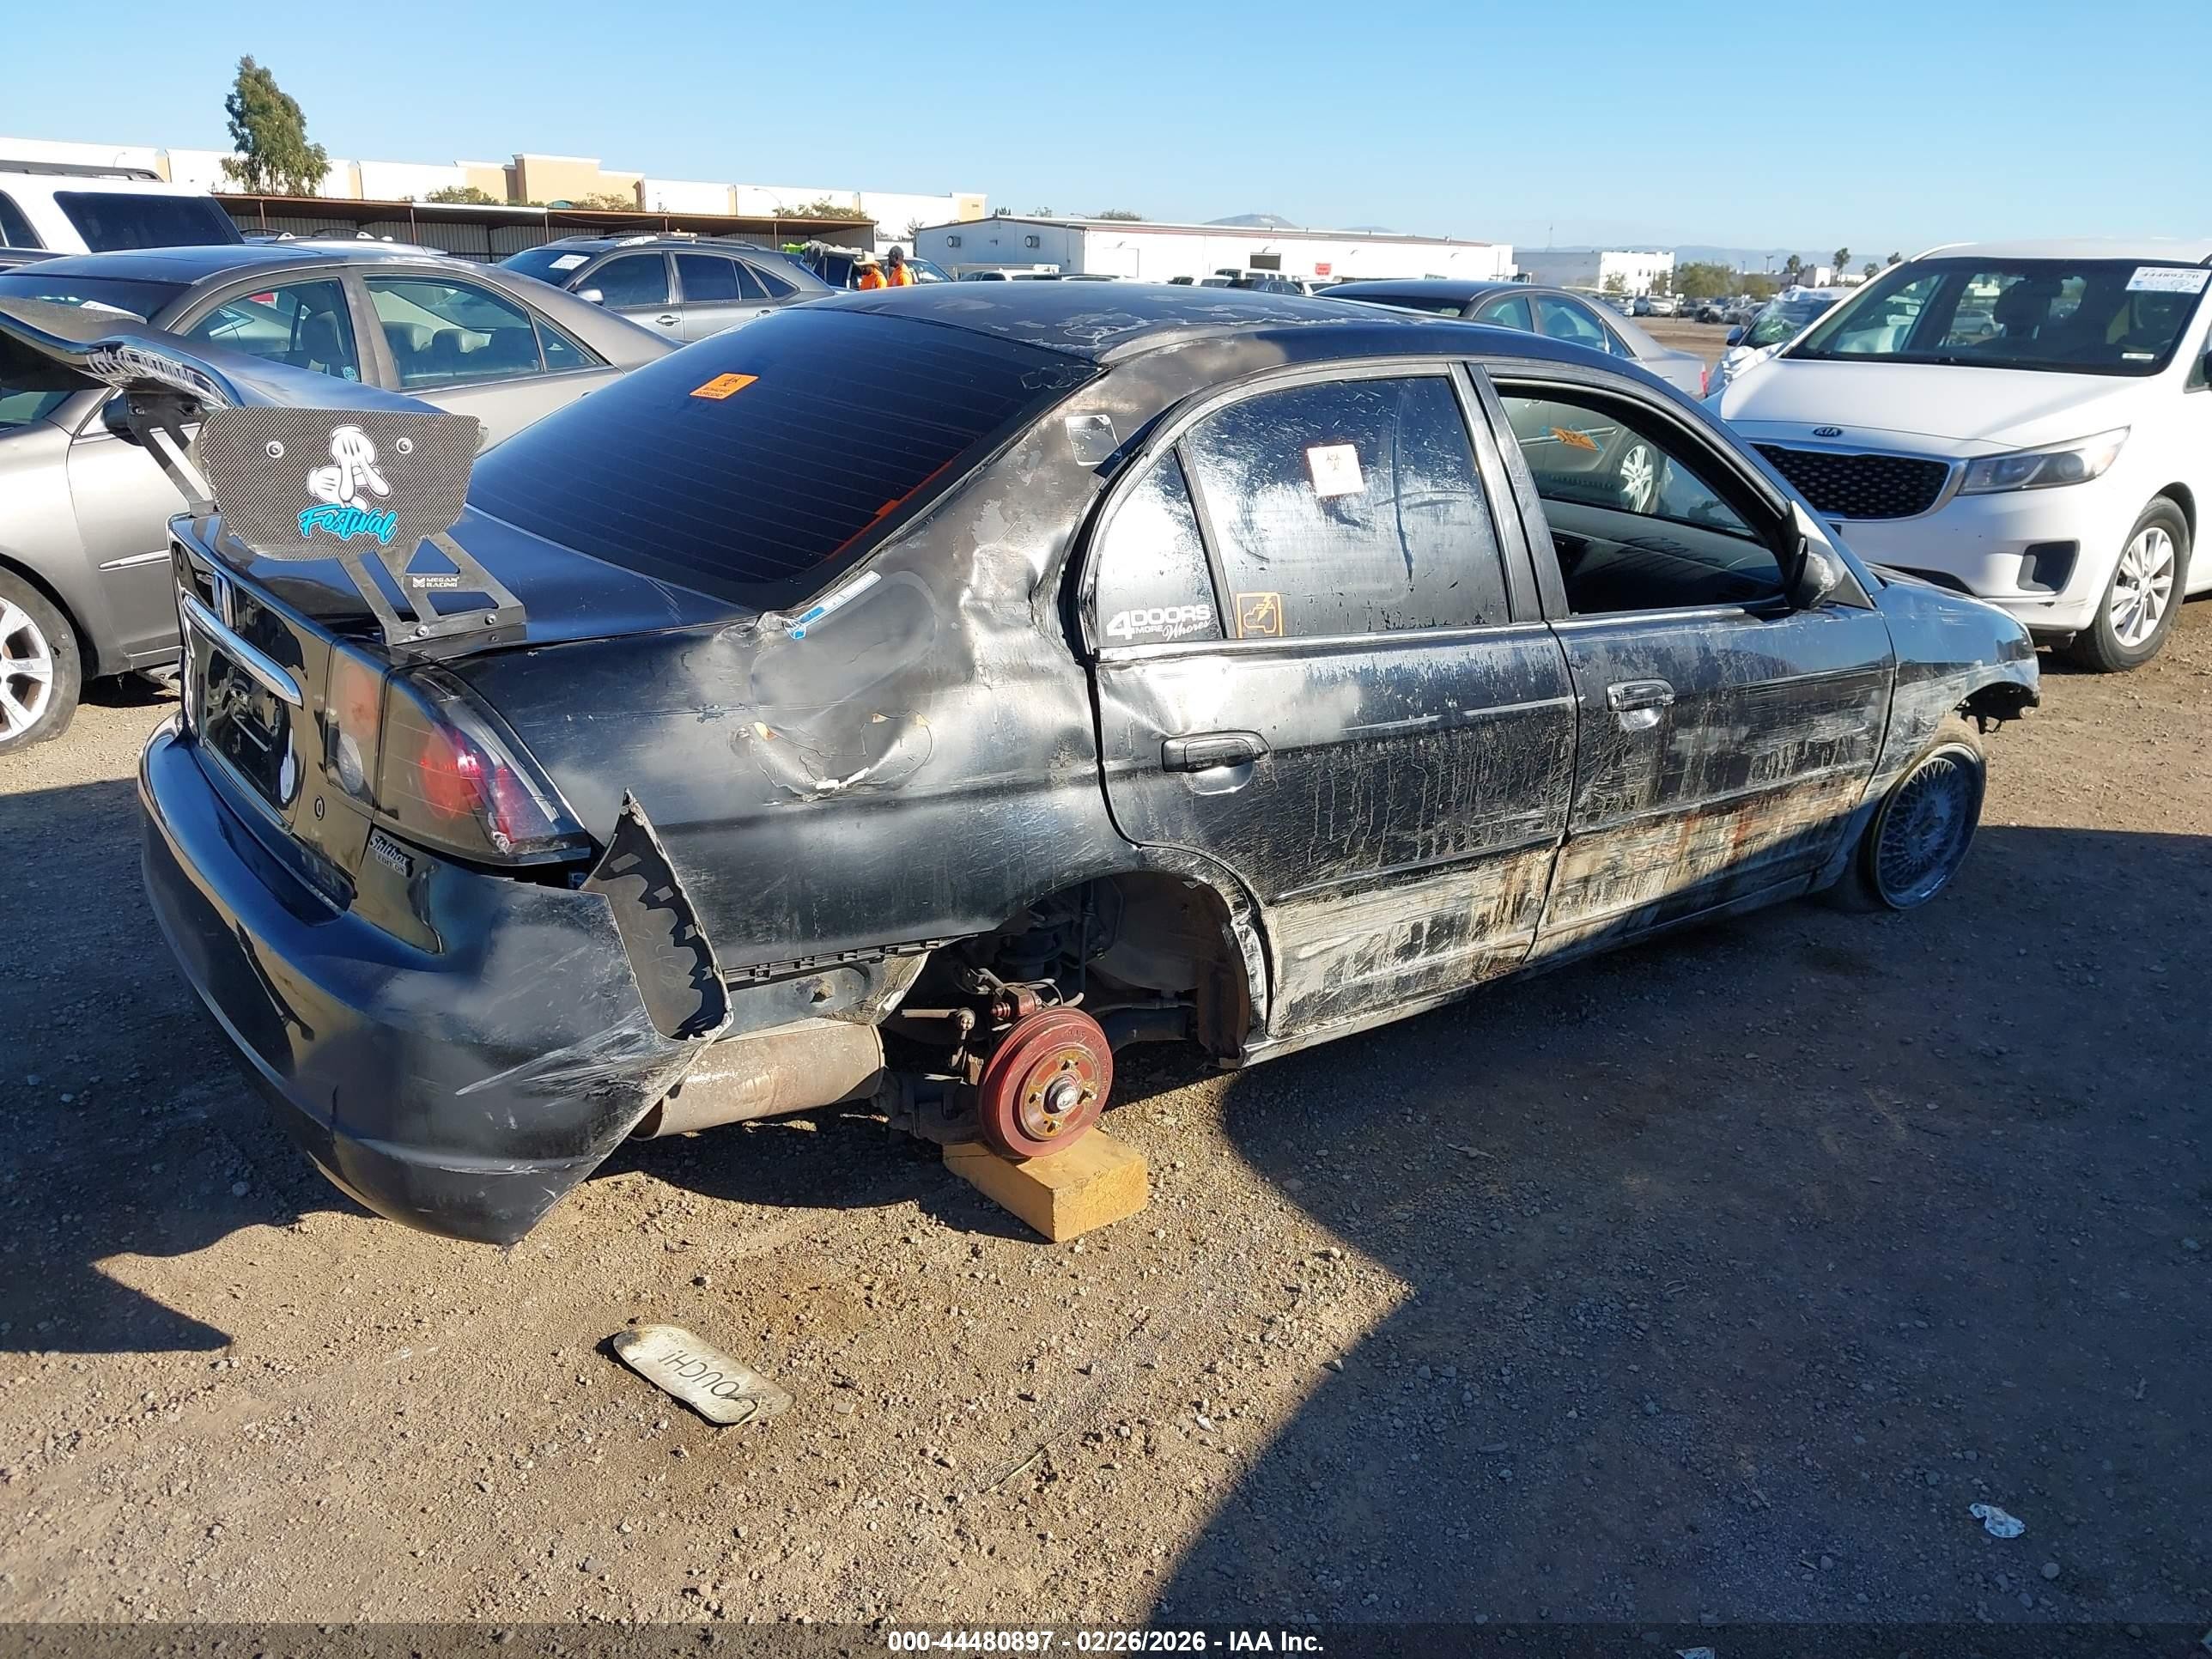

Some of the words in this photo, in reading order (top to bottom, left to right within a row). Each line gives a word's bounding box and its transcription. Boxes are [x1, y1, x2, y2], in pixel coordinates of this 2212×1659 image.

[1815, 428, 1838, 436] KIA
[299, 503, 397, 544] Festival
[1106, 611, 1133, 640] 4
[1130, 604, 1211, 627] DOORS
[1162, 619, 1211, 641] Whores
